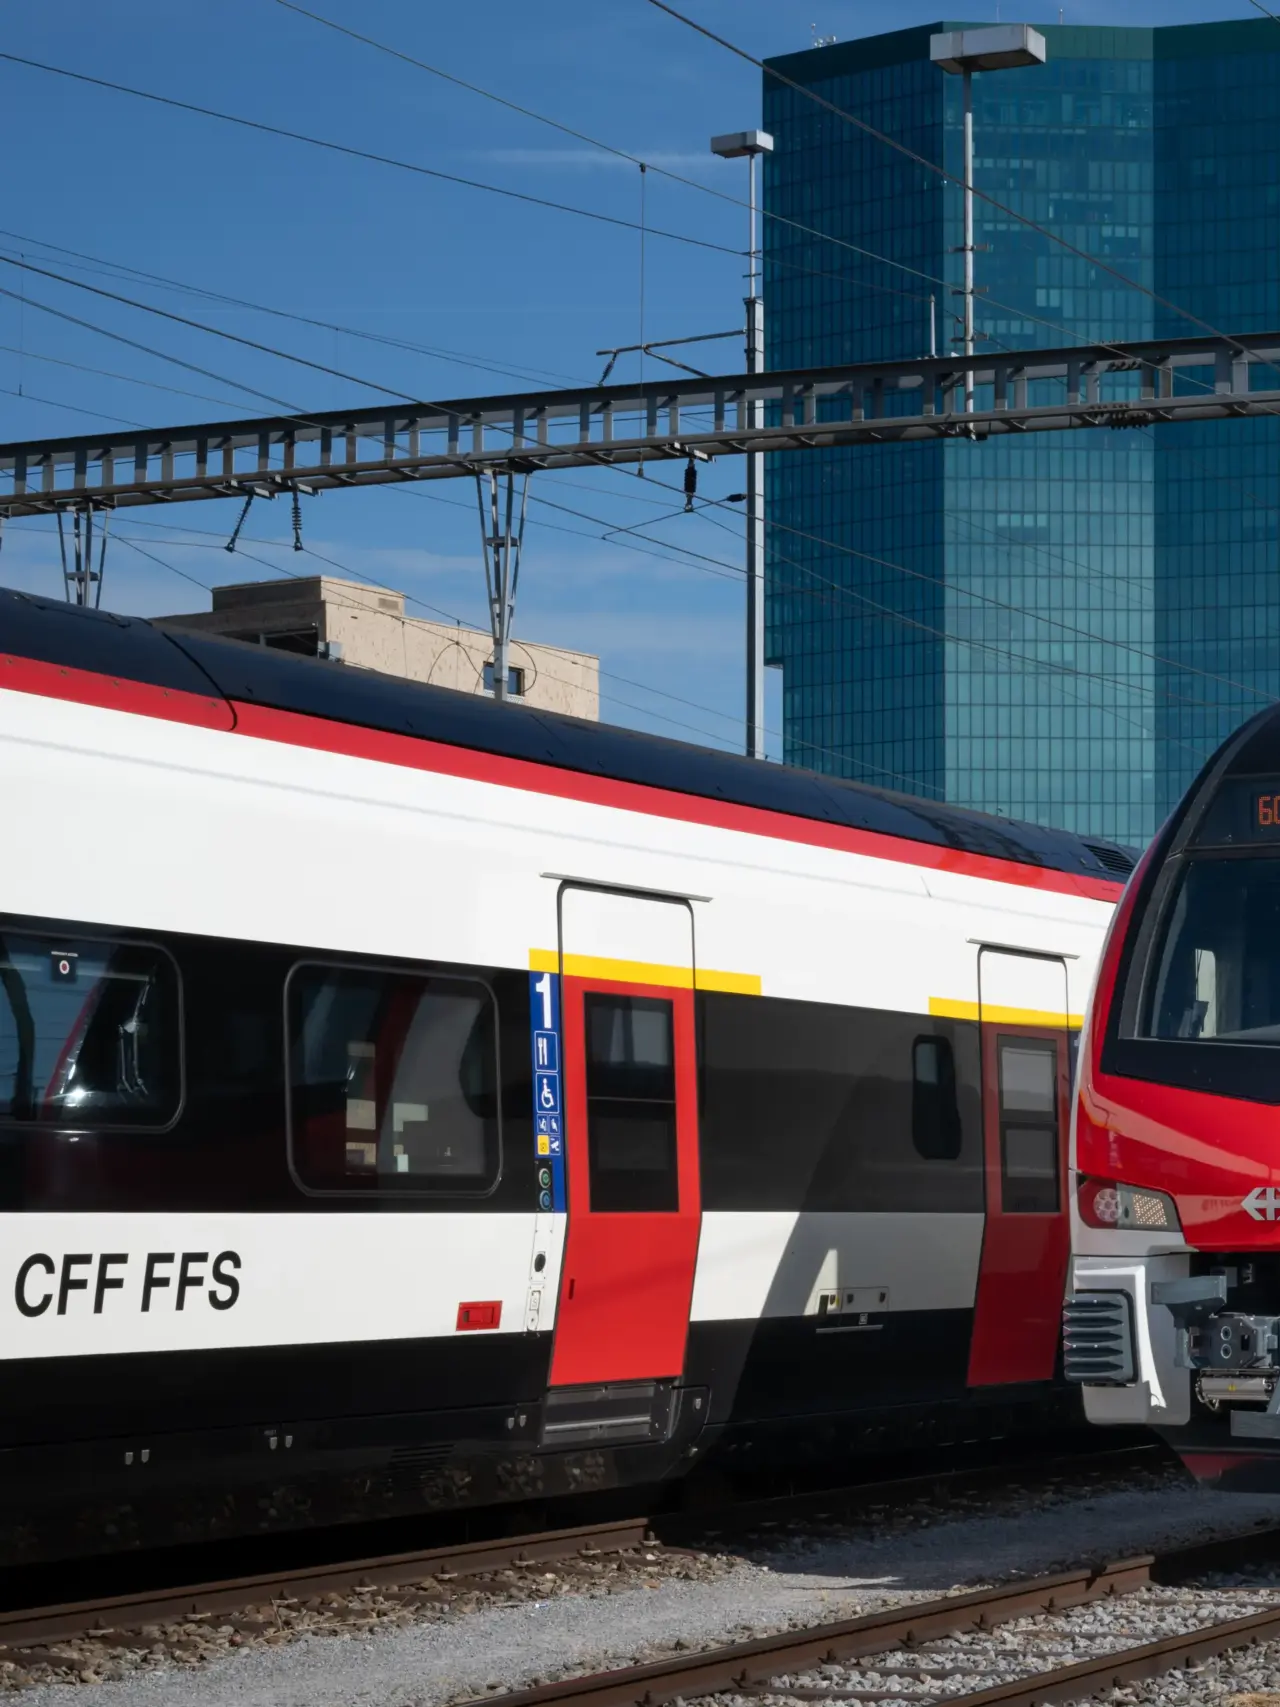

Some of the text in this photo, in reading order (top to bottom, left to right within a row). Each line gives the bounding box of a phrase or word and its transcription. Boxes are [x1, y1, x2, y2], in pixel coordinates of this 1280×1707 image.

[535, 973, 552, 1028] 1
[15, 1251, 242, 1317] CFF FFS
